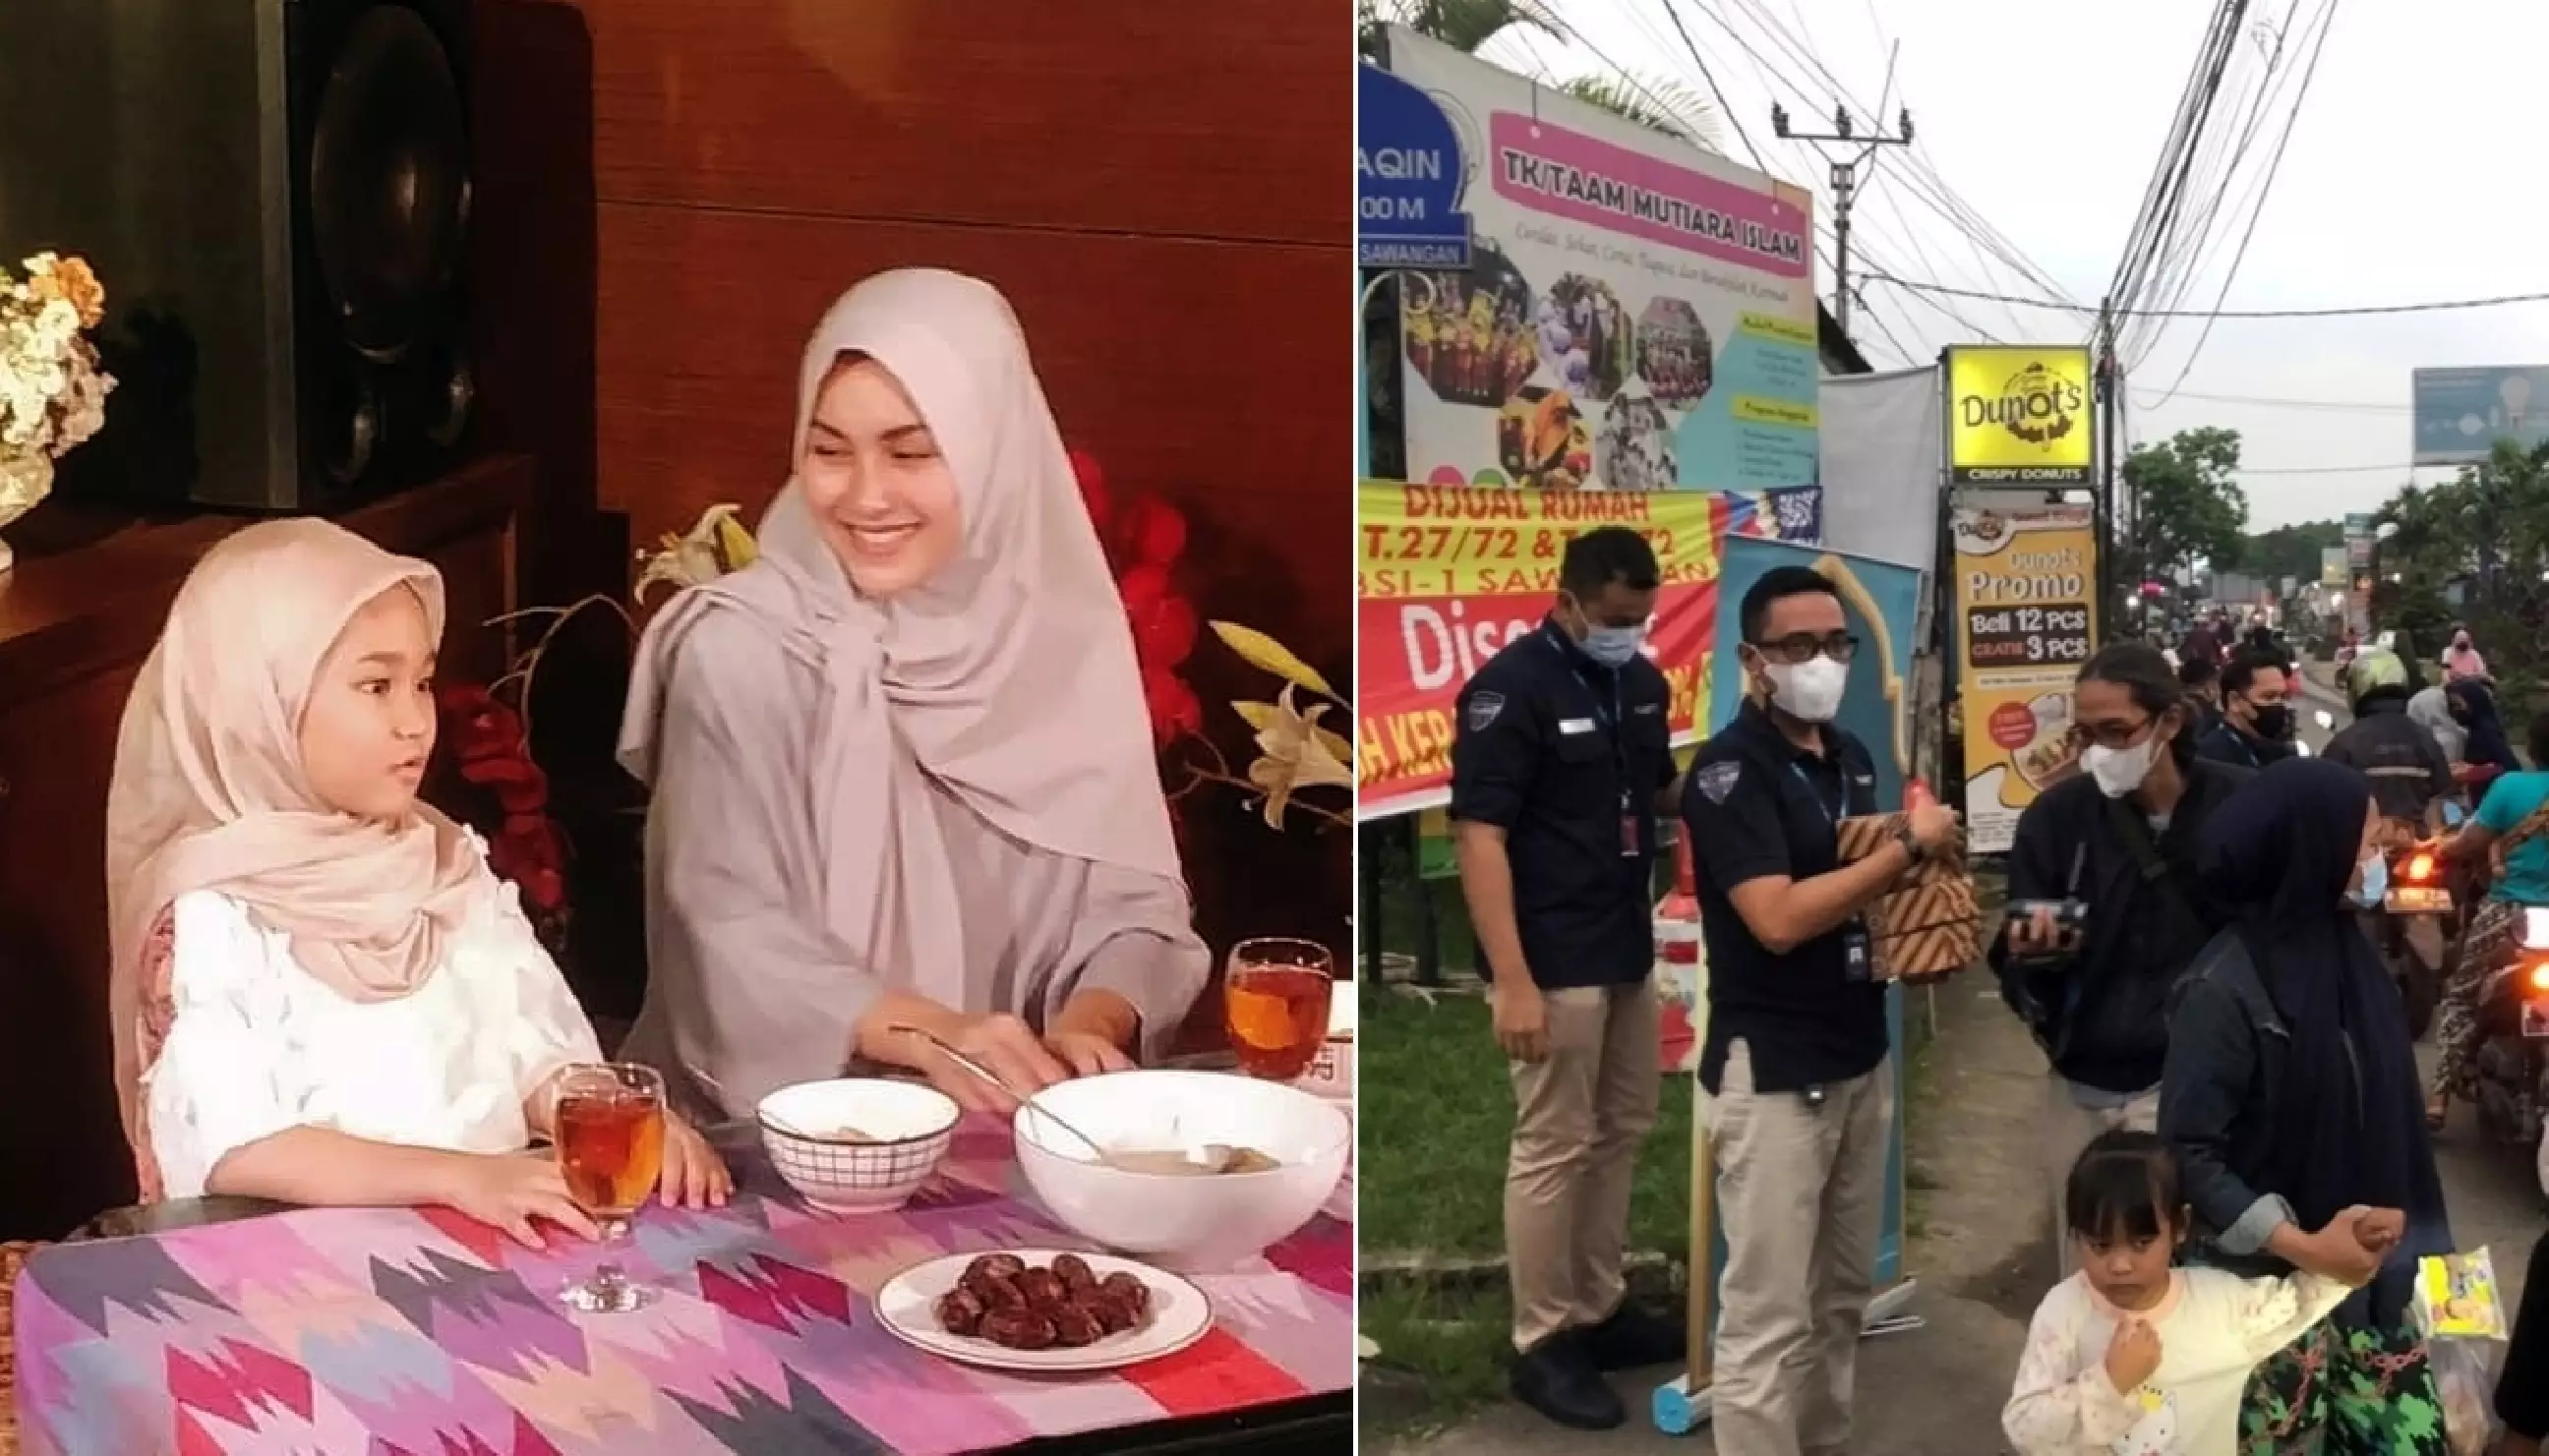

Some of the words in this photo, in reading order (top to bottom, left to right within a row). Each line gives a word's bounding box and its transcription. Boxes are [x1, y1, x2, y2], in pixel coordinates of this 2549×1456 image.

[1398, 198, 1425, 219] M
[1501, 147, 1626, 213] TK/TAAM
[1631, 186, 1735, 243] MUTIARA
[1741, 220, 1803, 262] ISLAM
[1360, 244, 1460, 263] SAWANGAN
[2021, 468, 2082, 480] DONUTS
[1402, 484, 1530, 519] DIJUAL
[1541, 489, 1649, 521] RUMAH
[1363, 524, 1518, 562] T.27/72
[1532, 529, 1556, 559] &
[1971, 571, 2082, 601] Promo
[2015, 607, 2044, 631] 12
[2046, 610, 2086, 631] PCS
[2027, 635, 2045, 661] 3
[2046, 638, 2087, 659] PCS
